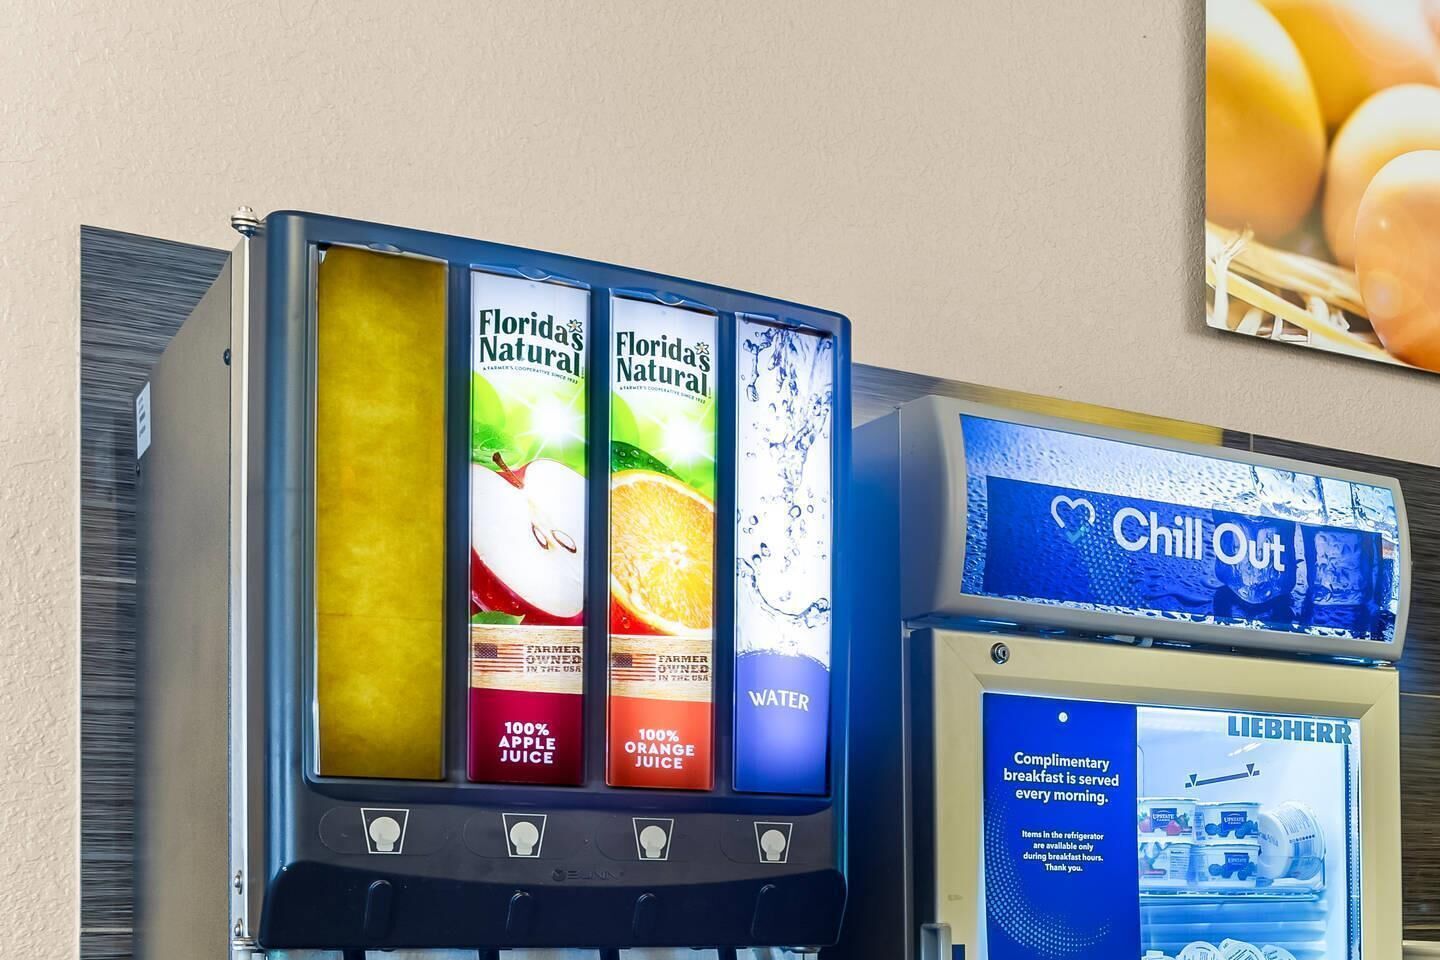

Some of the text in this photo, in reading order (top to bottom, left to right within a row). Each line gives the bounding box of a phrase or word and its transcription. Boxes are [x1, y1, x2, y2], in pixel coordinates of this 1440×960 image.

[480, 336, 580, 377] Natural
[515, 366, 550, 376] COOPERATIVE
[551, 372, 566, 381] SINCE
[617, 357, 708, 397] Natural
[648, 385, 680, 396] COOPERATIVE
[1113, 507, 1285, 572] Chill Out
[526, 645, 581, 653] FARMER
[526, 655, 582, 664] OWNED
[658, 655, 708, 663] FARMER
[658, 665, 709, 673] OWNED
[749, 689, 809, 711] WATER
[505, 721, 550, 736] 100%
[639, 728, 680, 743] 100%
[1228, 716, 1352, 744] LIEBHERR
[498, 735, 556, 750] APPLE
[624, 741, 695, 757] ORANGE
[500, 749, 554, 764] JUICE
[635, 755, 683, 769] JUICE
[1014, 752, 1110, 773] Complimentary
[1003, 768, 1119, 786] breakfast is served
[1016, 789, 1108, 806] every morning.
[1022, 830, 1104, 841] Items in the refrigerator
[1046, 842, 1077, 850] available
[1078, 843, 1094, 852] only
[1023, 852, 1104, 862] during breakfast hours.
[1045, 863, 1083, 873] Thank you.
